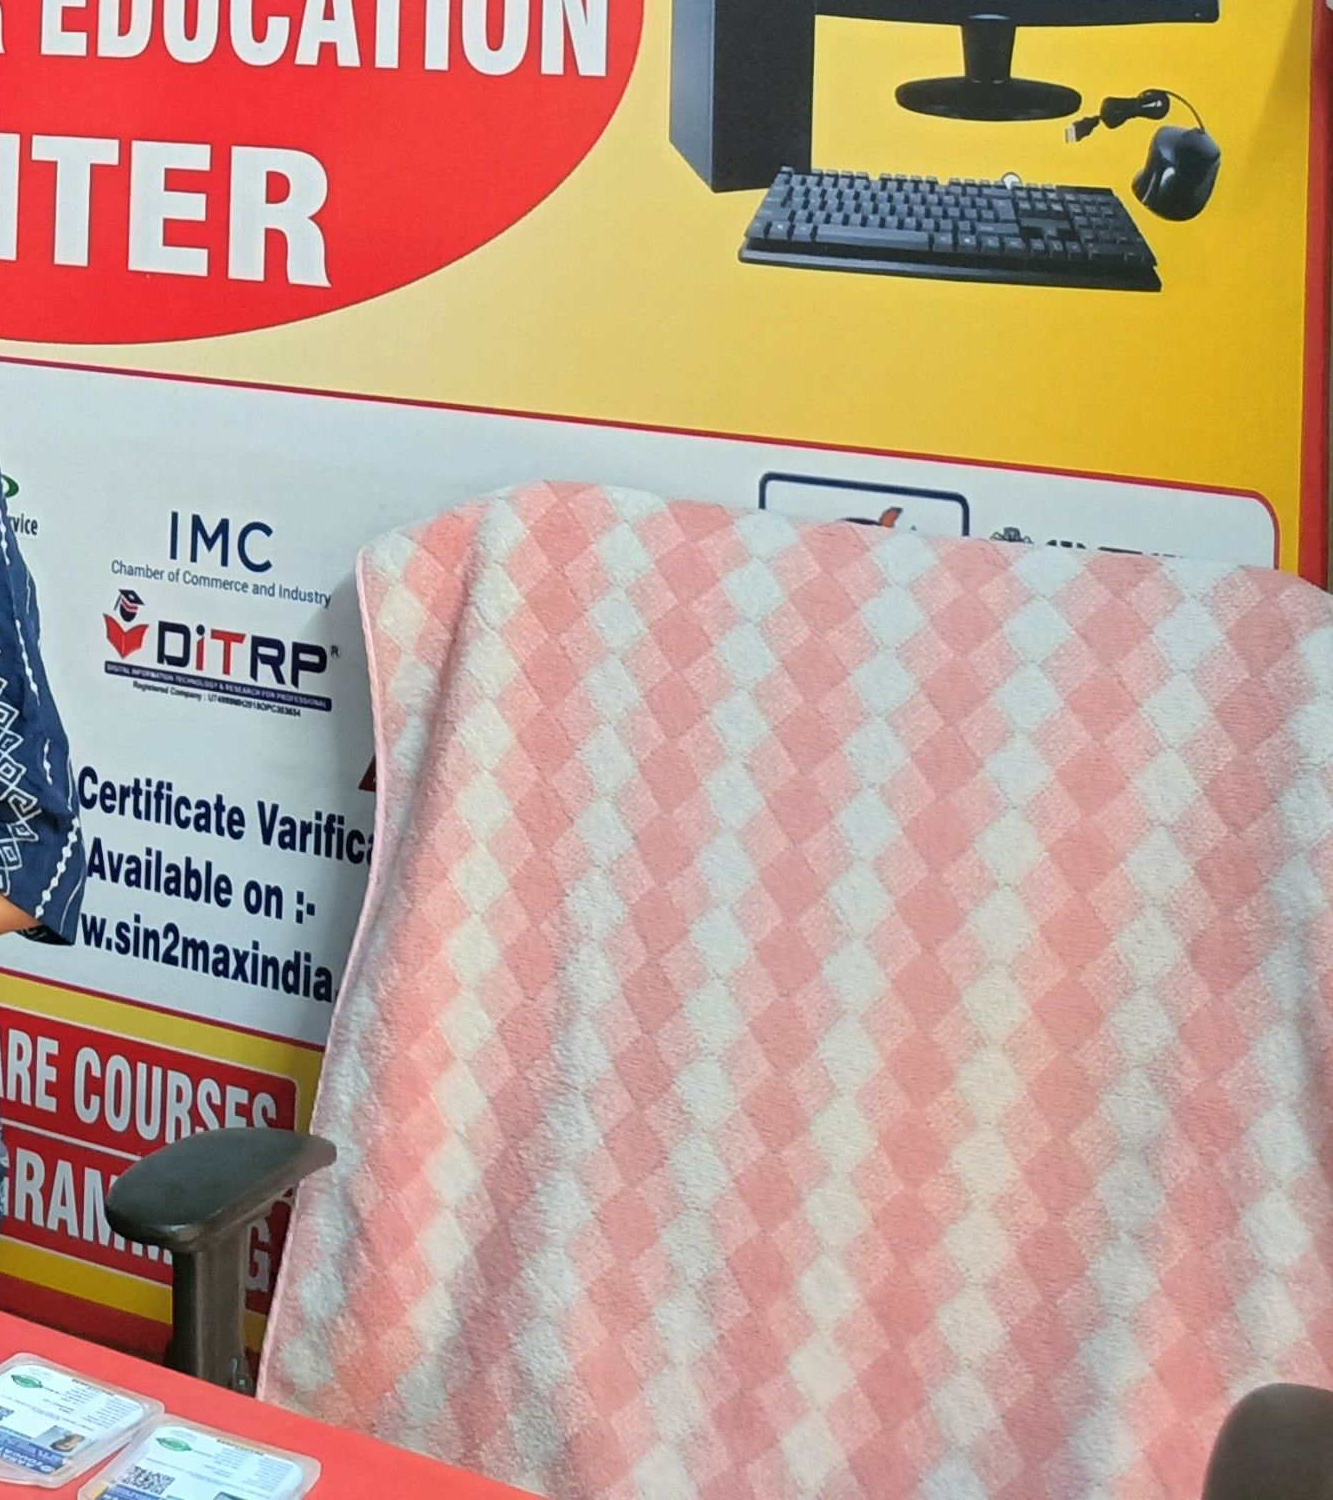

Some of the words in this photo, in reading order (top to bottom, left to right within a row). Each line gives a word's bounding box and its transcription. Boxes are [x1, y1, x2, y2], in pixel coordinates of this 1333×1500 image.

[169, 510, 274, 573] IMC
[110, 559, 165, 581] Chamber
[167, 567, 181, 584] of
[182, 570, 249, 593] Commerce
[252, 582, 276, 598] and
[278, 583, 332, 609] Industry
[77, 766, 247, 840] Certificate
[86, 838, 233, 908] Available
[243, 880, 284, 920] on
[74, 1045, 277, 1144] COURSES
